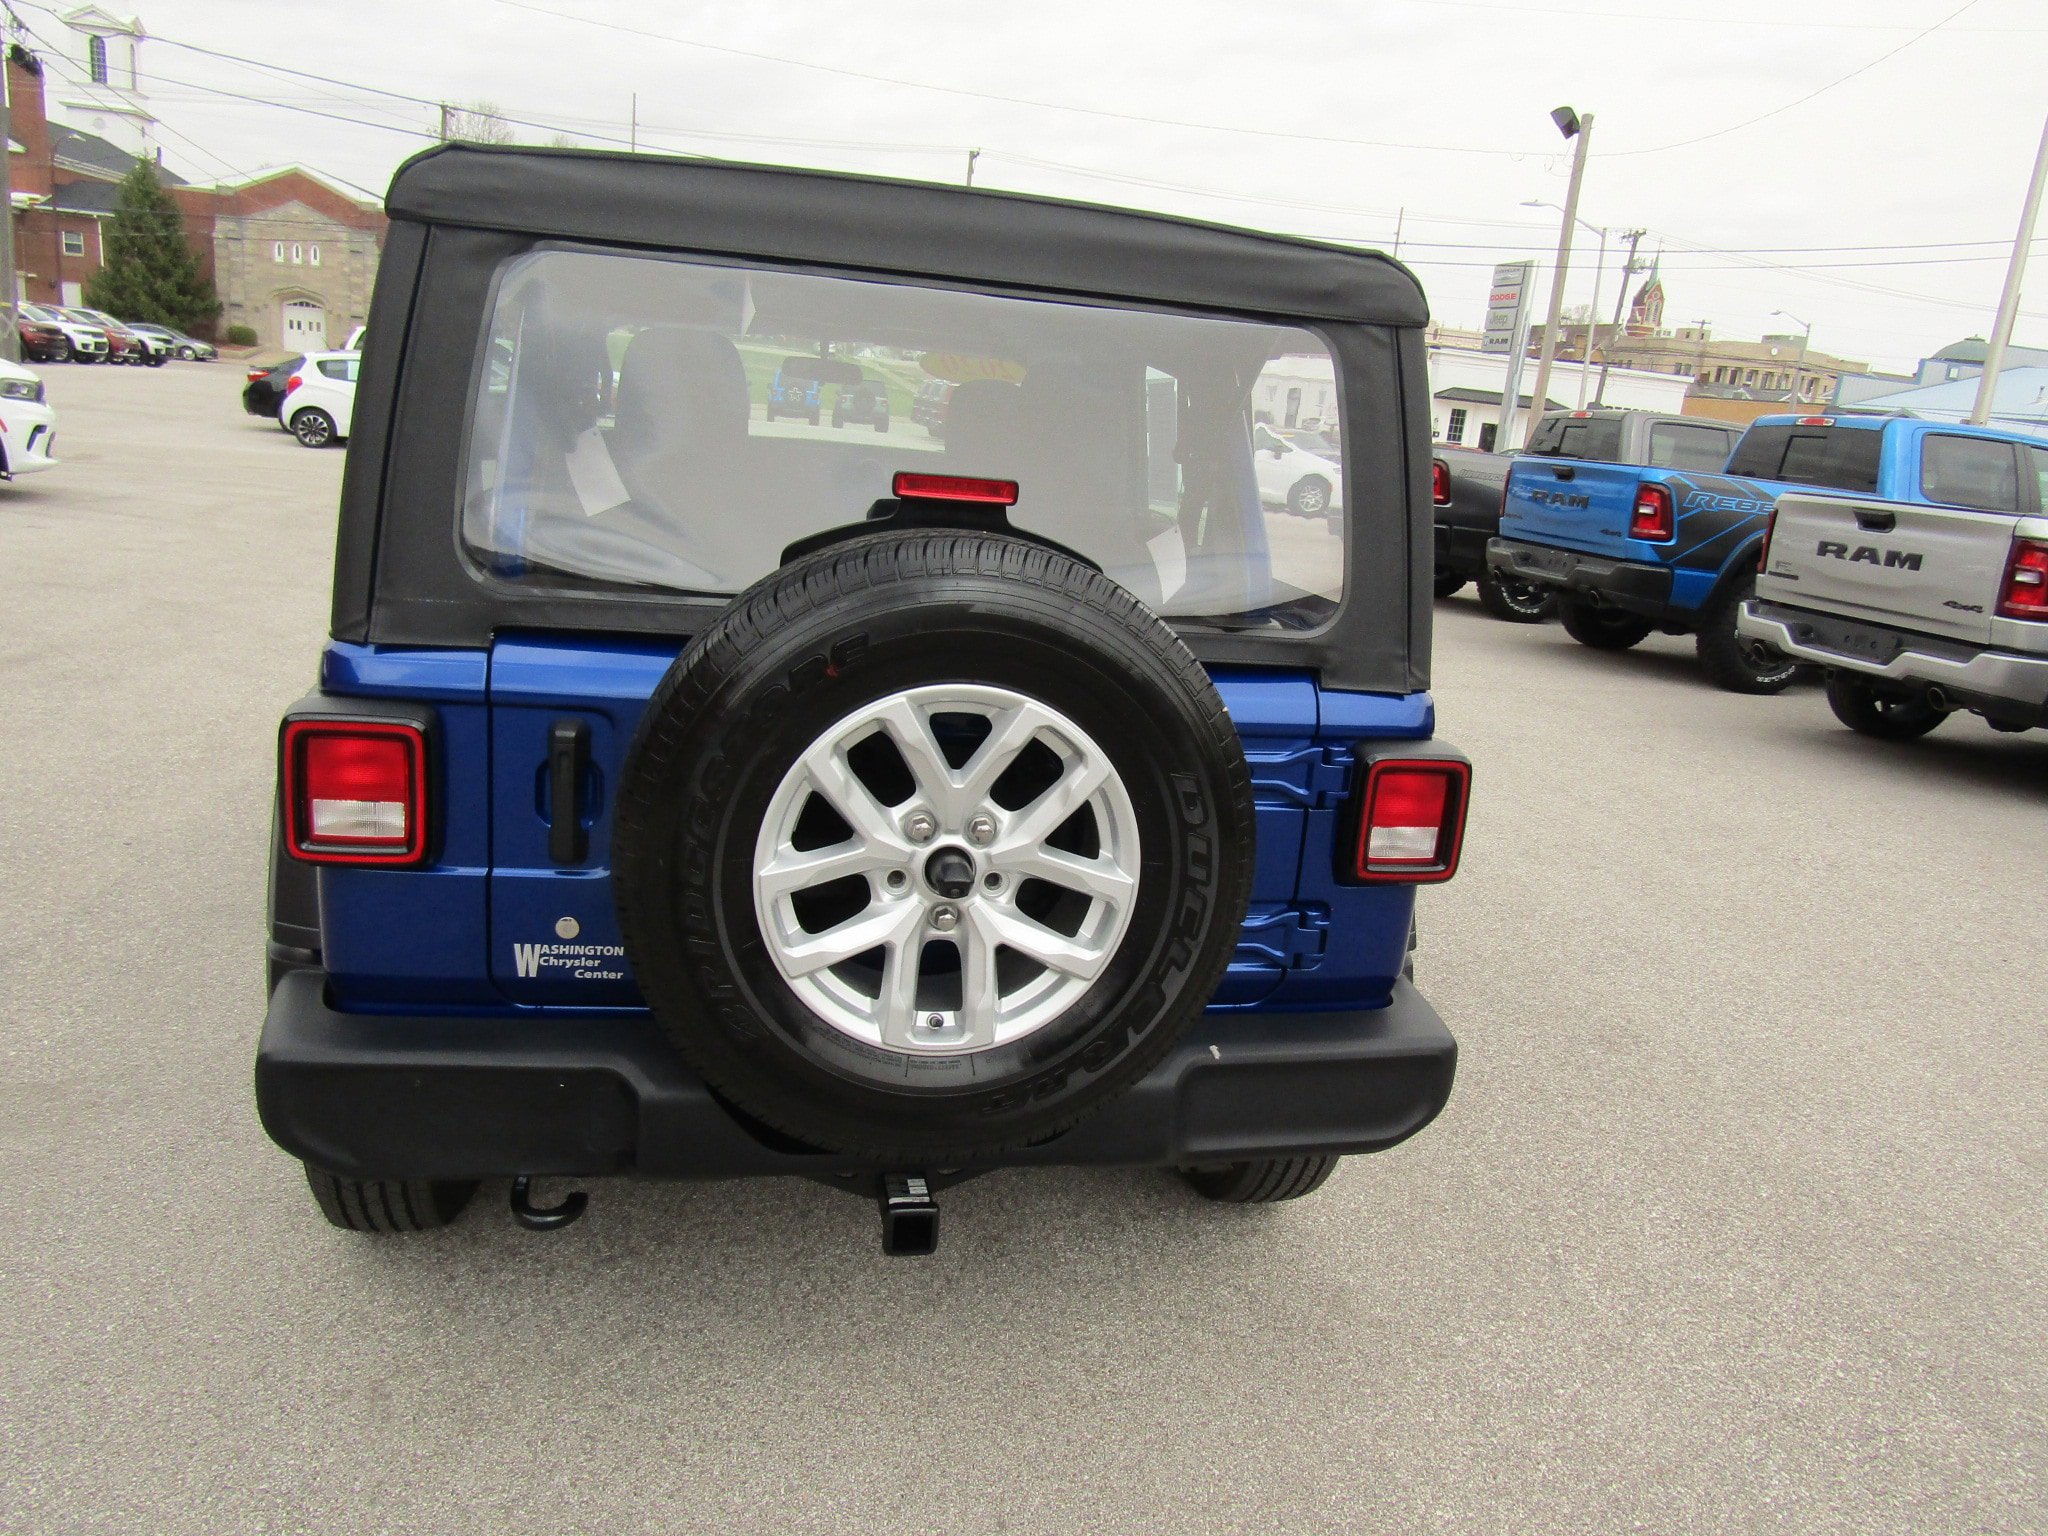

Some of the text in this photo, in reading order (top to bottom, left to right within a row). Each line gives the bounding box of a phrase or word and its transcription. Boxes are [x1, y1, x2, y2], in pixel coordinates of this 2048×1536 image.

[1490, 293, 1517, 302] DODGE
[1532, 489, 1590, 509] RAM
[1817, 541, 1923, 571] RAM
[513, 943, 624, 977] WASHINGTON
[540, 956, 601, 968] Chrysler
[574, 969, 623, 979] Center
